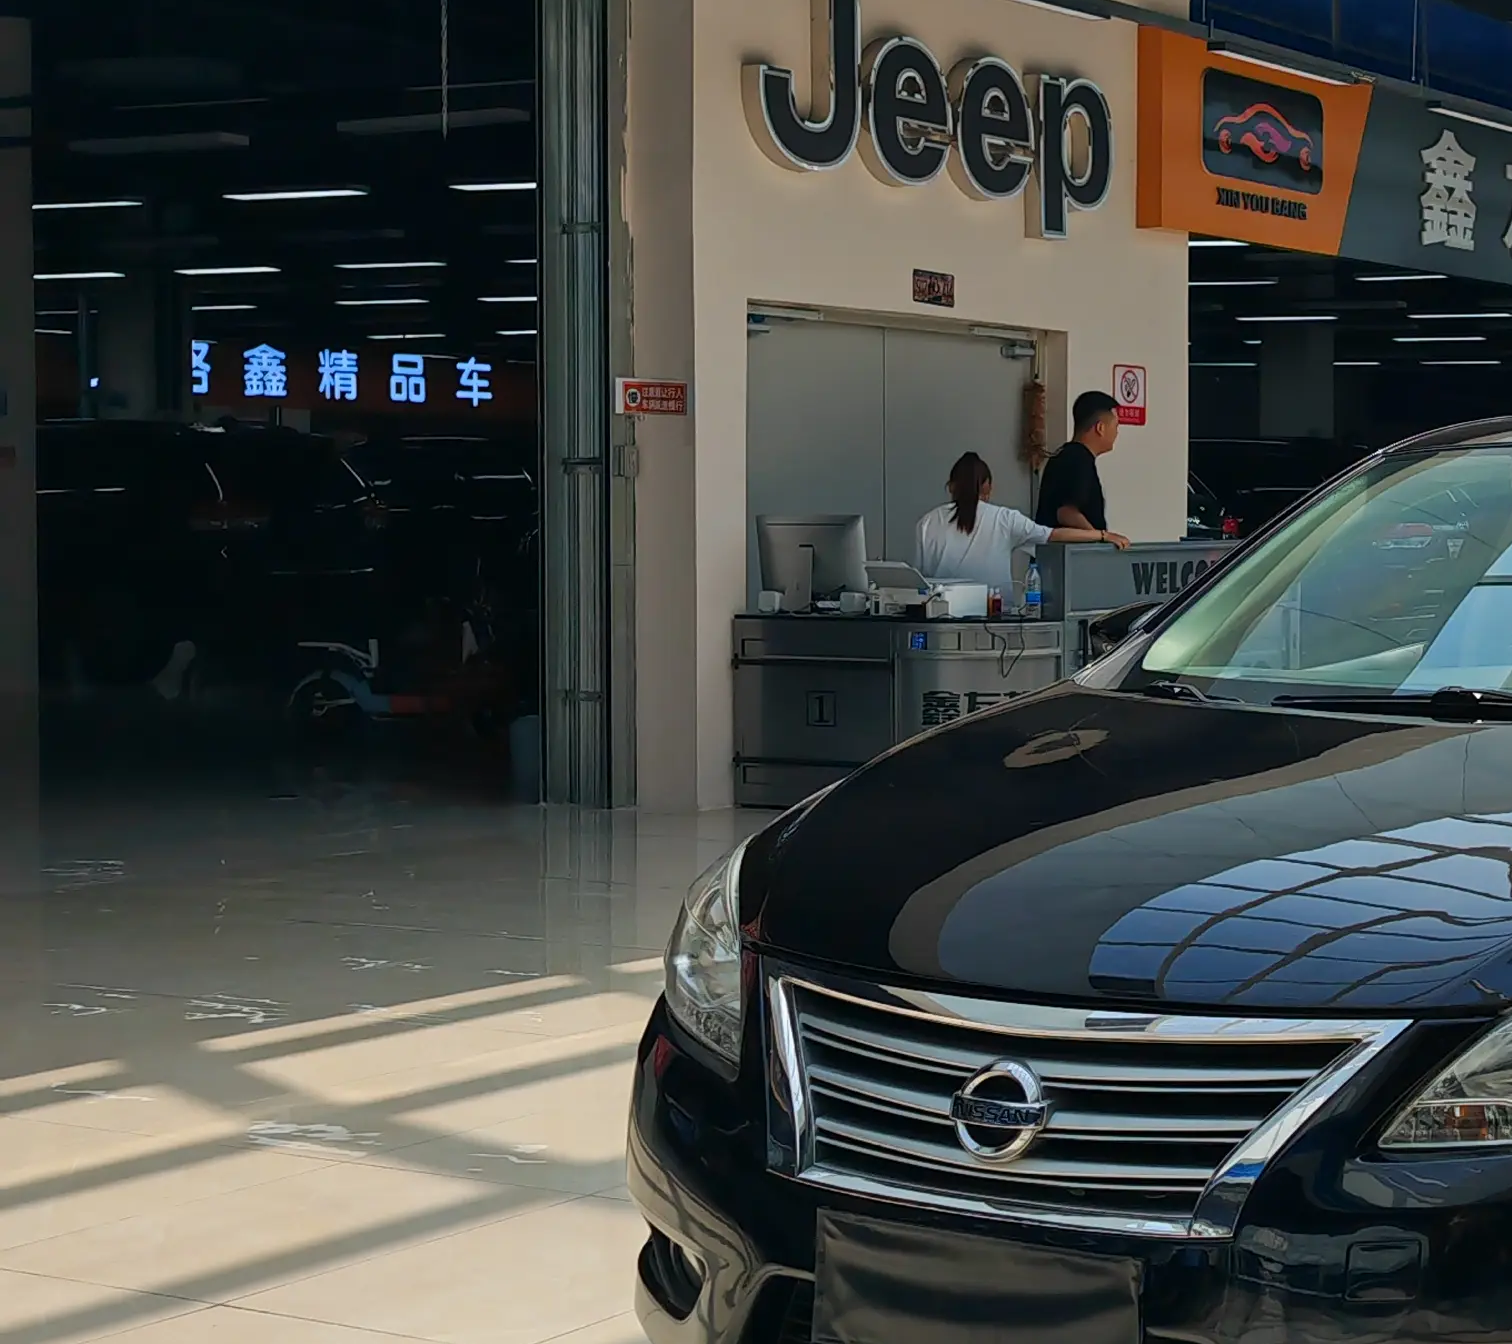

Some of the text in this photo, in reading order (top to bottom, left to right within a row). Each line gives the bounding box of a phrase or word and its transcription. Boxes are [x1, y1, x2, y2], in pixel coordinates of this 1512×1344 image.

[1216, 187, 1308, 220] XIN YOU BANG
[954, 1099, 1031, 1124] NISSAN
